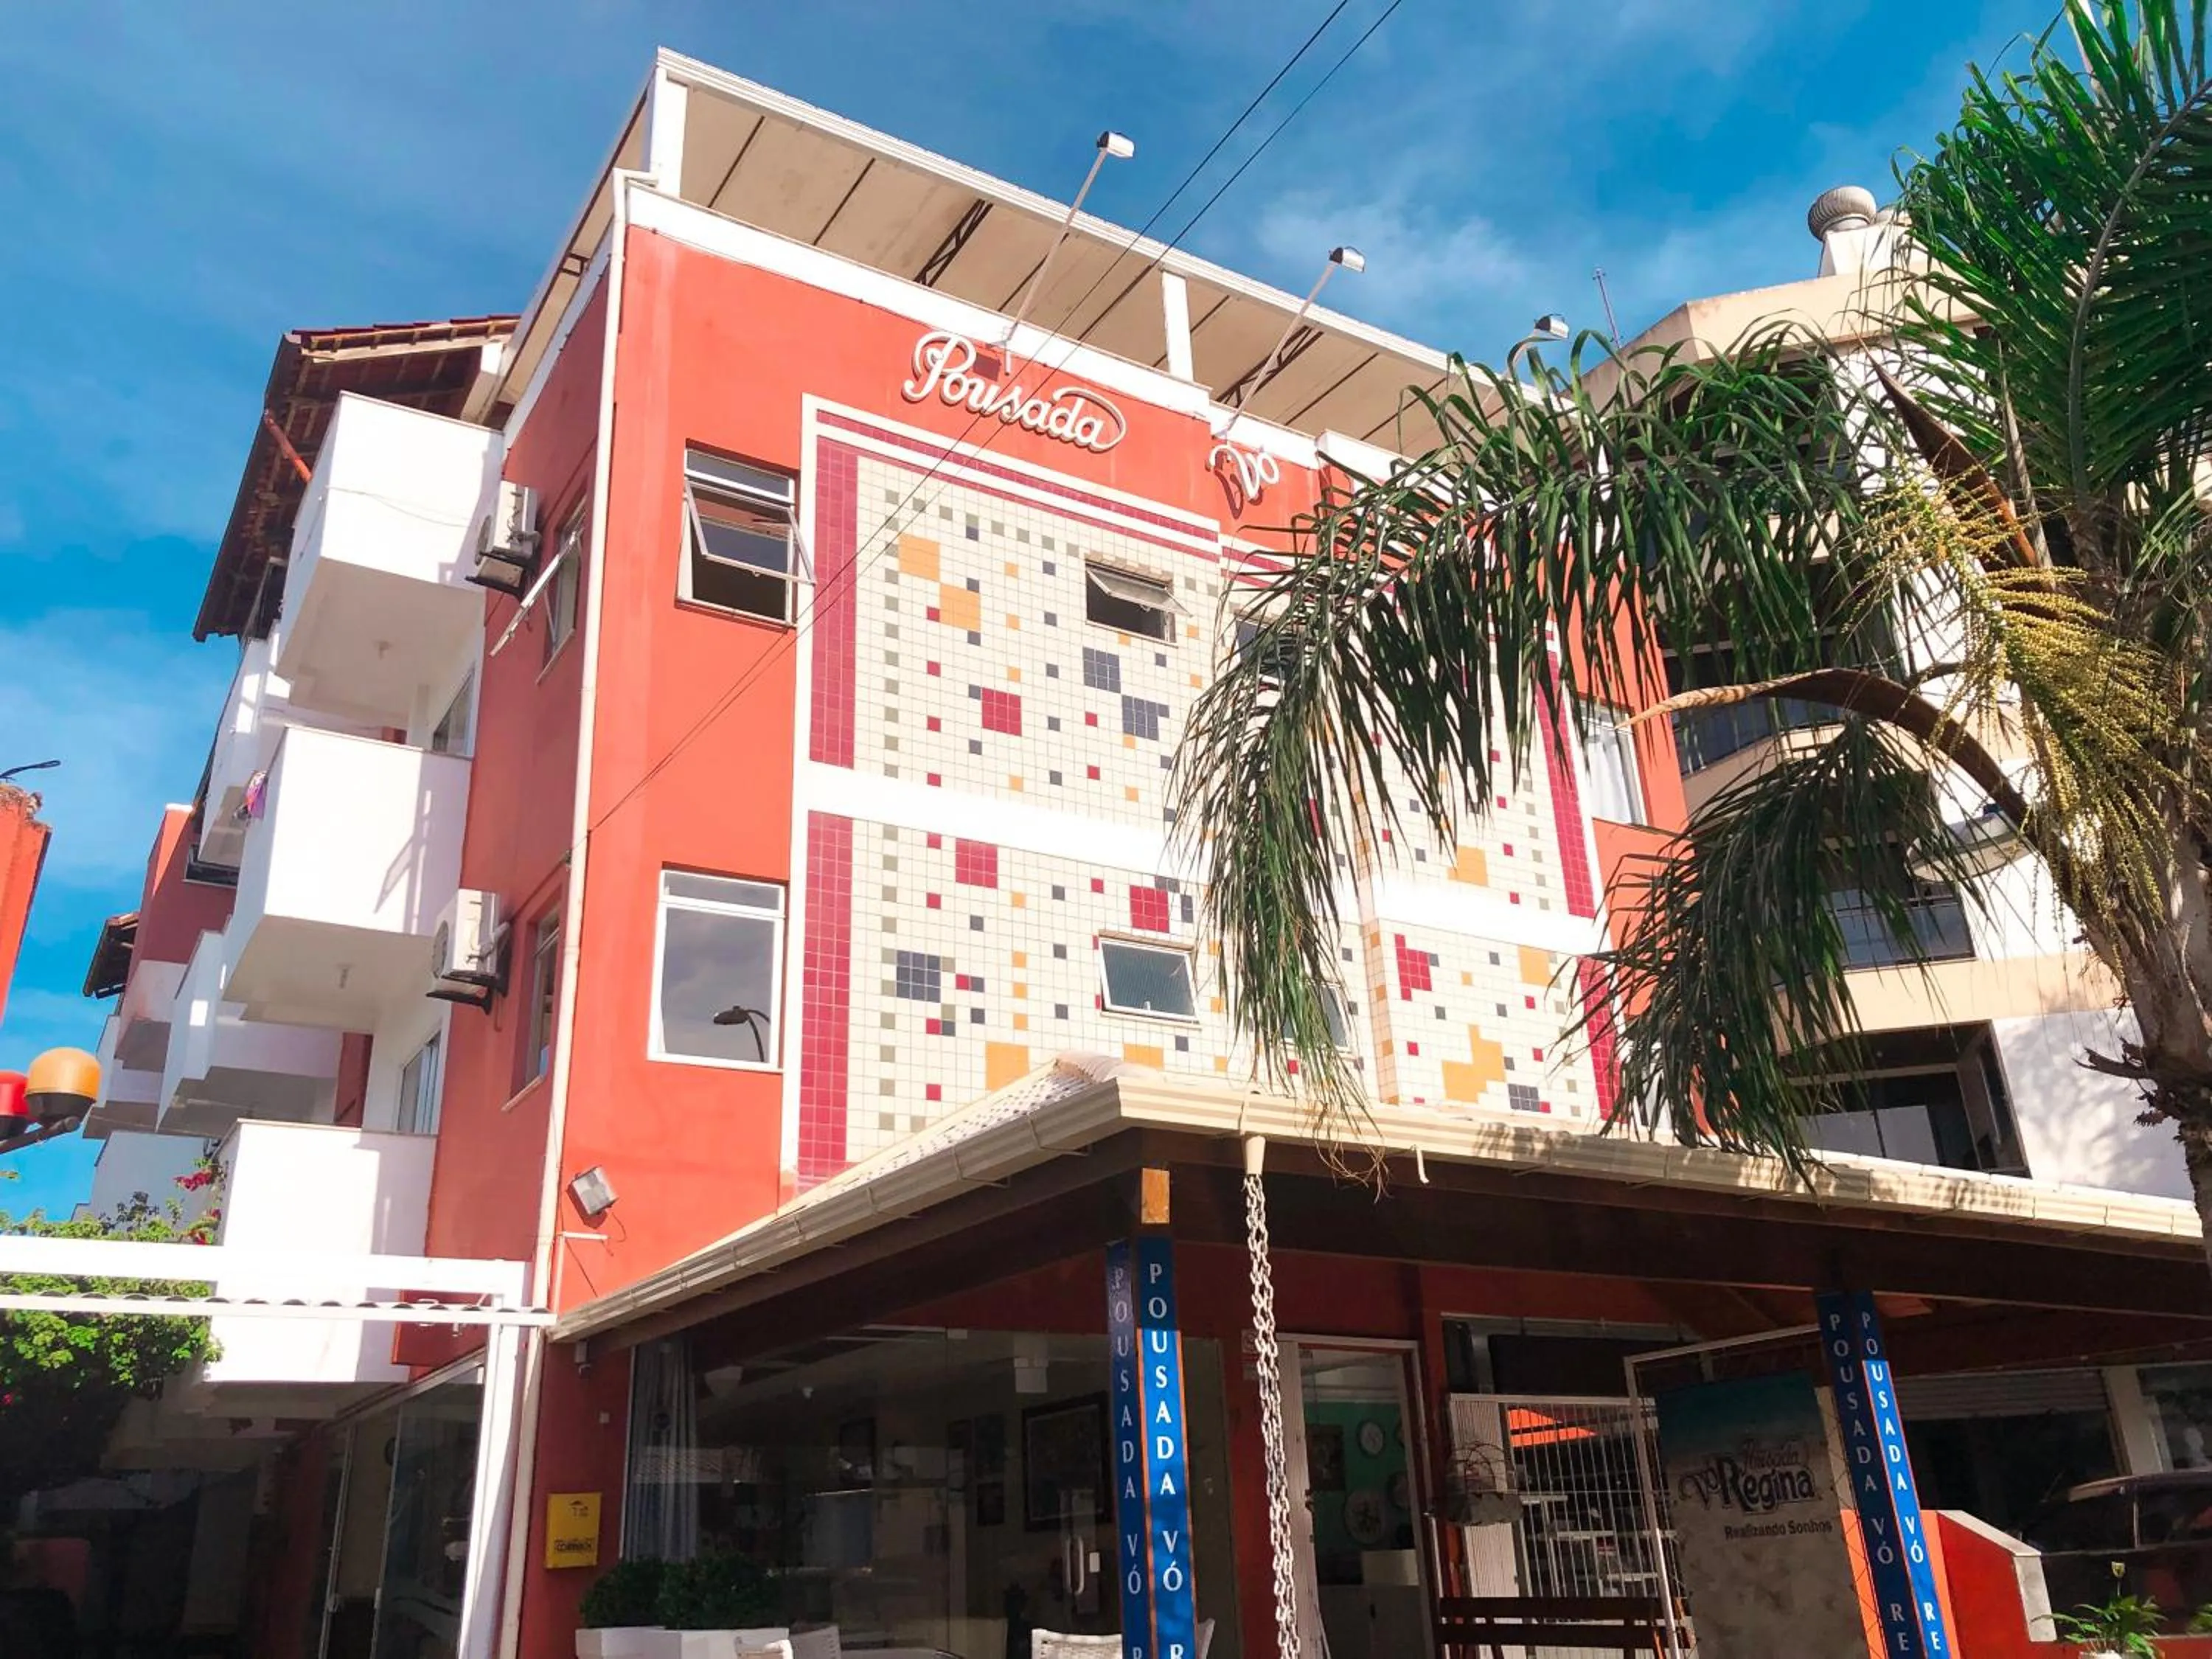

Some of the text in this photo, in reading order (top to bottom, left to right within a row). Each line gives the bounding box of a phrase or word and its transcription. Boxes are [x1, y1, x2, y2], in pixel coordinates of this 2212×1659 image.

[902, 331, 1127, 452] Pousada
[1111, 1267, 1136, 1499] POUSADA
[1127, 1534, 1142, 1596] VÓ
[1149, 1263, 1176, 1495] POUSADA
[1163, 1530, 1183, 1591] VÓ
[1715, 1455, 1816, 1513] Regina
[1787, 1520, 1833, 1535] Sonhos
[1829, 1314, 1878, 1492] POUSADA
[1871, 1517, 1894, 1565] VÓ
[1861, 1312, 1908, 1490] POUSADA
[1904, 1516, 1924, 1562] VÓ
